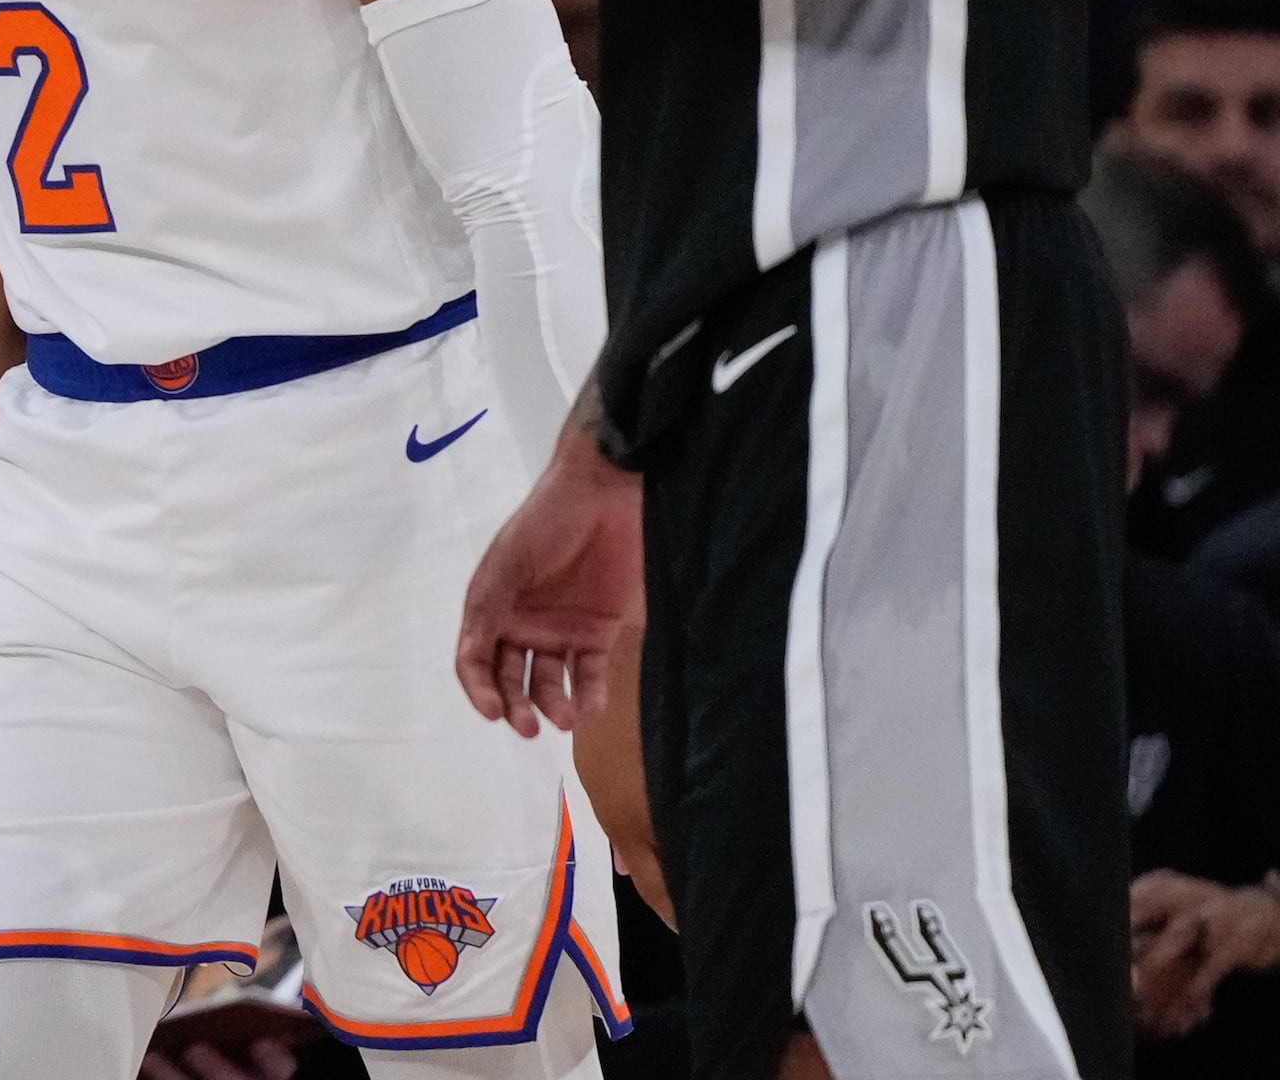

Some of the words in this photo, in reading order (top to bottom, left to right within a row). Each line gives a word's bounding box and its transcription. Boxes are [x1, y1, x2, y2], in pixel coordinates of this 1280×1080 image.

[389, 878, 414, 895] NEW
[416, 876, 447, 891] YORK
[355, 886, 496, 942] KNICKS
